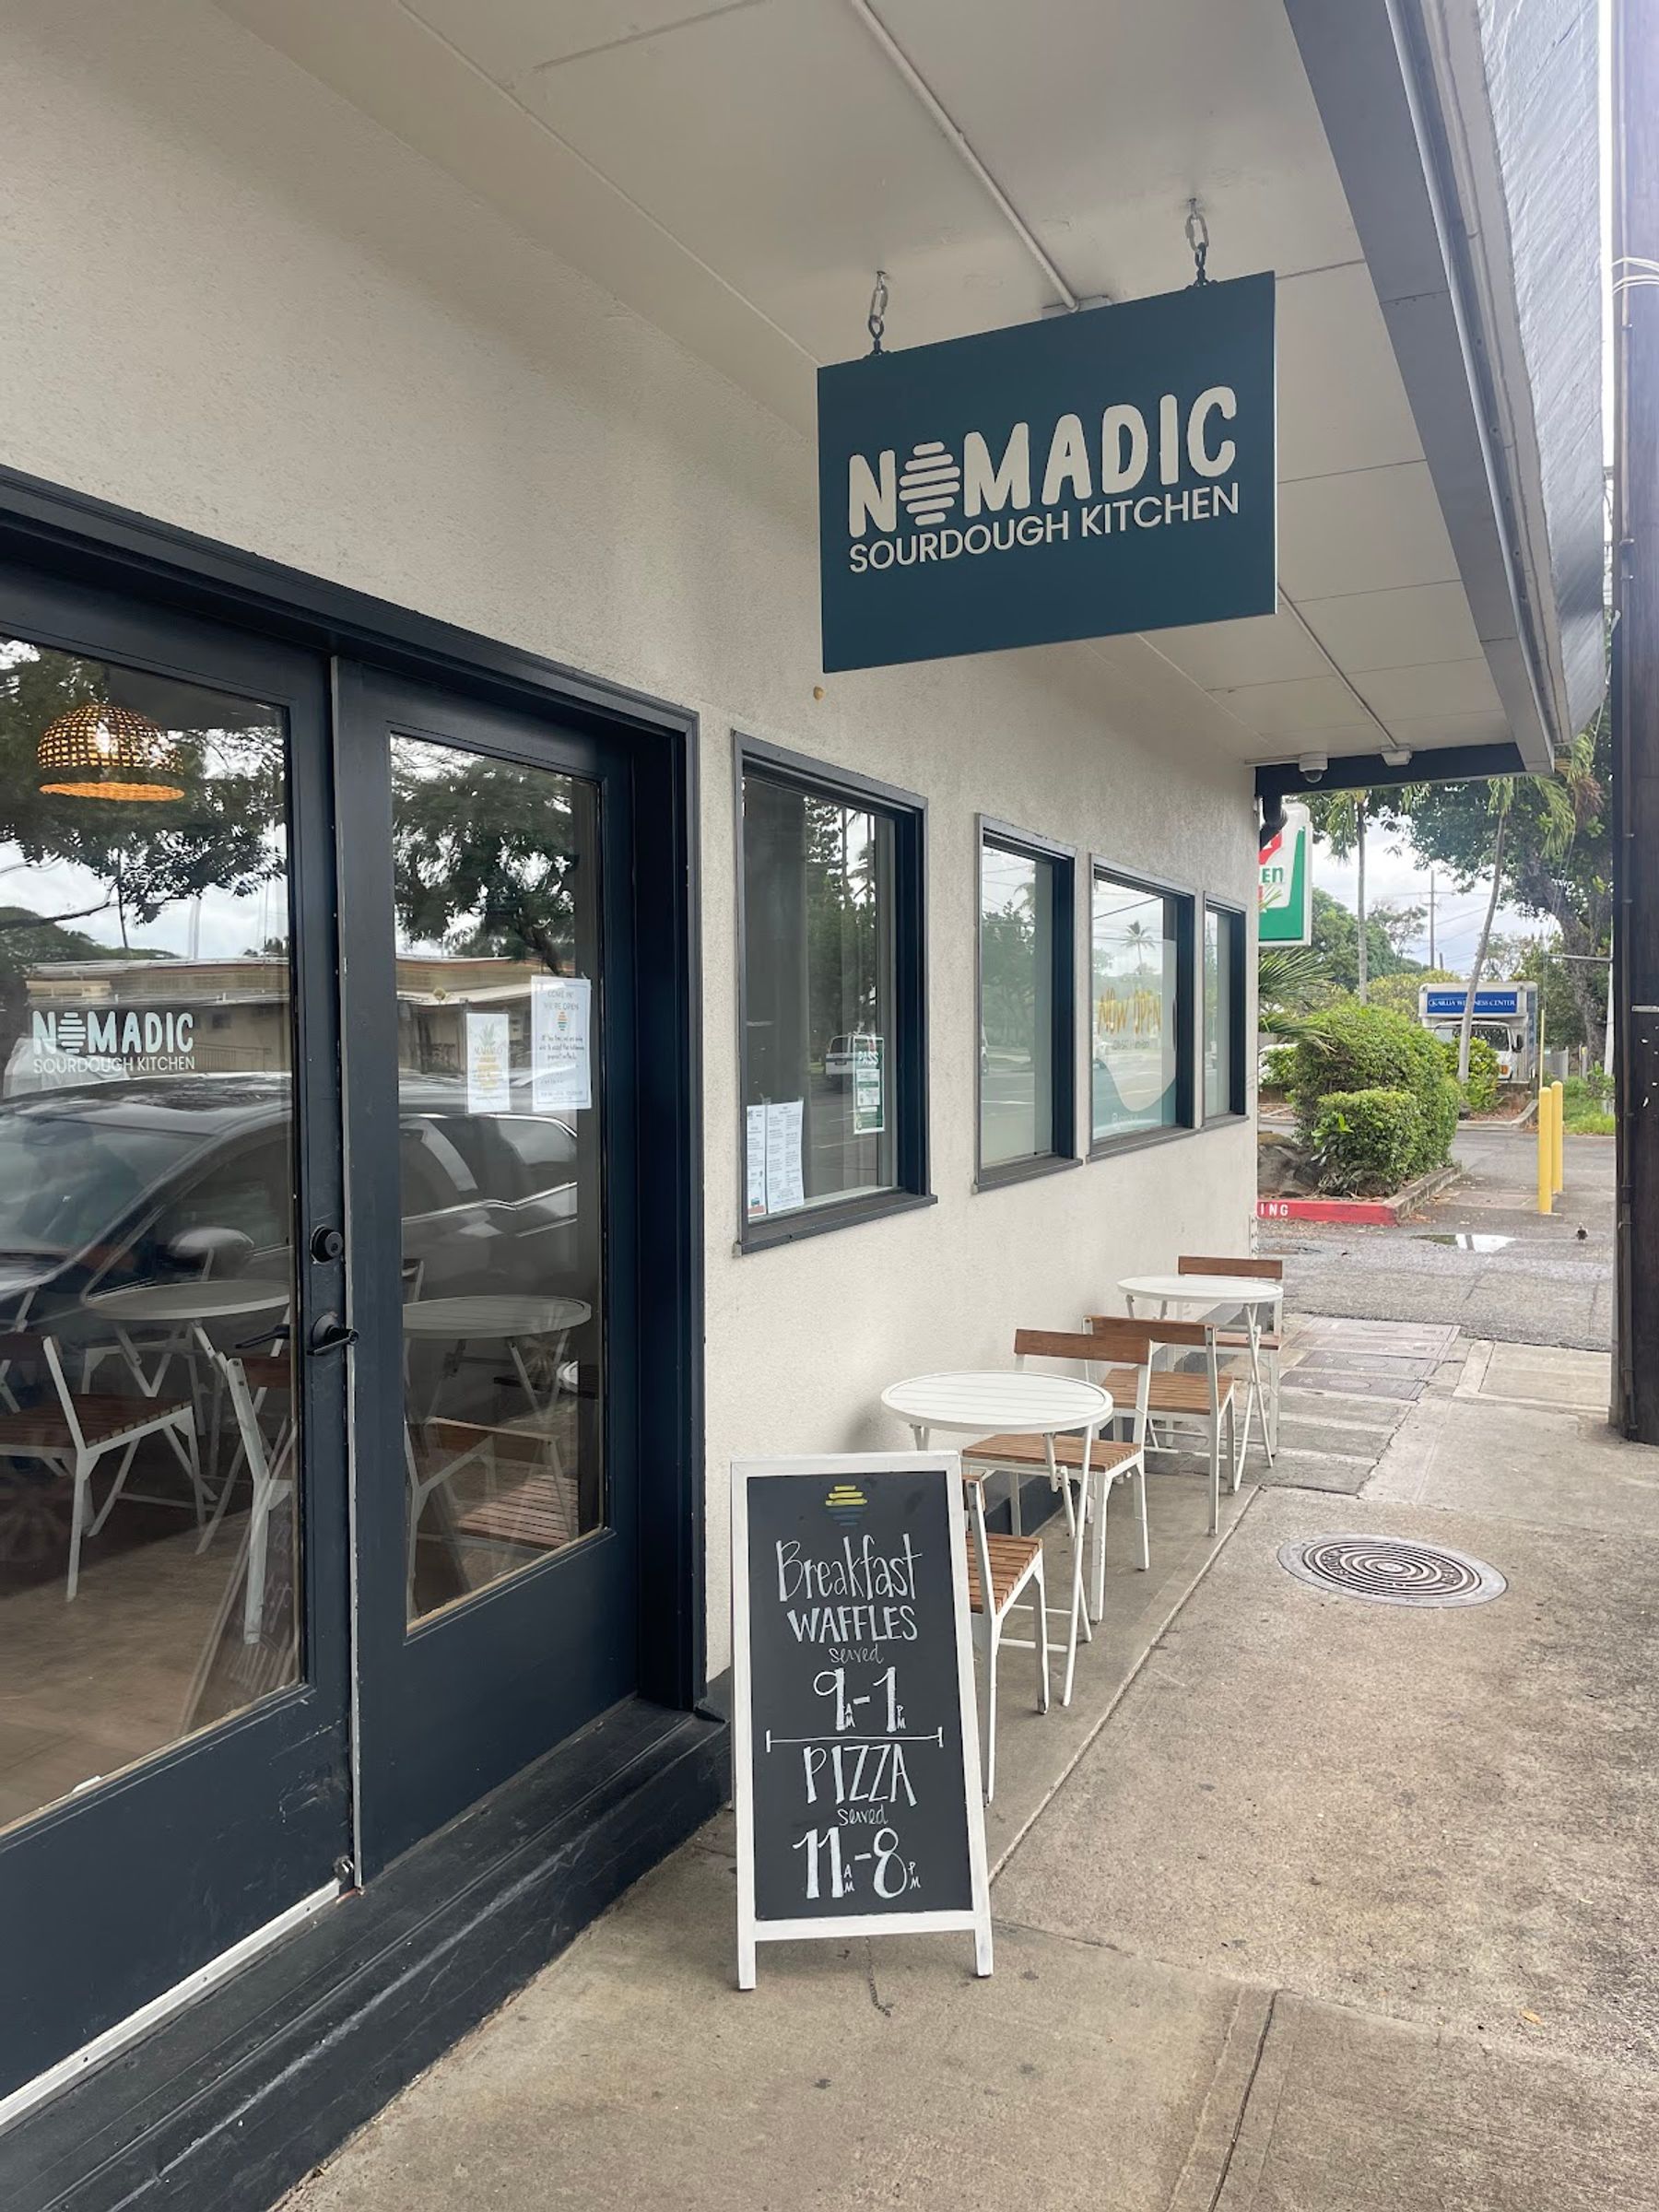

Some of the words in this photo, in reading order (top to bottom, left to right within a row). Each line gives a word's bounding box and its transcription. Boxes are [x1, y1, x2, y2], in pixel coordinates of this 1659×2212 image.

[848, 386, 1238, 538] NOMADIC
[849, 510, 1070, 573] SOURDOUGH
[1081, 482, 1239, 538] KITCHEN
[32, 1010, 194, 1054] NOMADIC
[33, 1056, 134, 1075] SOURDOUGH
[137, 1055, 195, 1072] KITCHEN
[857, 1051, 879, 1065] PASS
[1260, 1203, 1288, 1216] ING
[775, 1533, 923, 1602] Breakfast
[786, 1605, 918, 1643] WAFFLES
[829, 1643, 885, 1663] served
[803, 1743, 917, 1806] PIZZA
[837, 1804, 888, 1826] served
